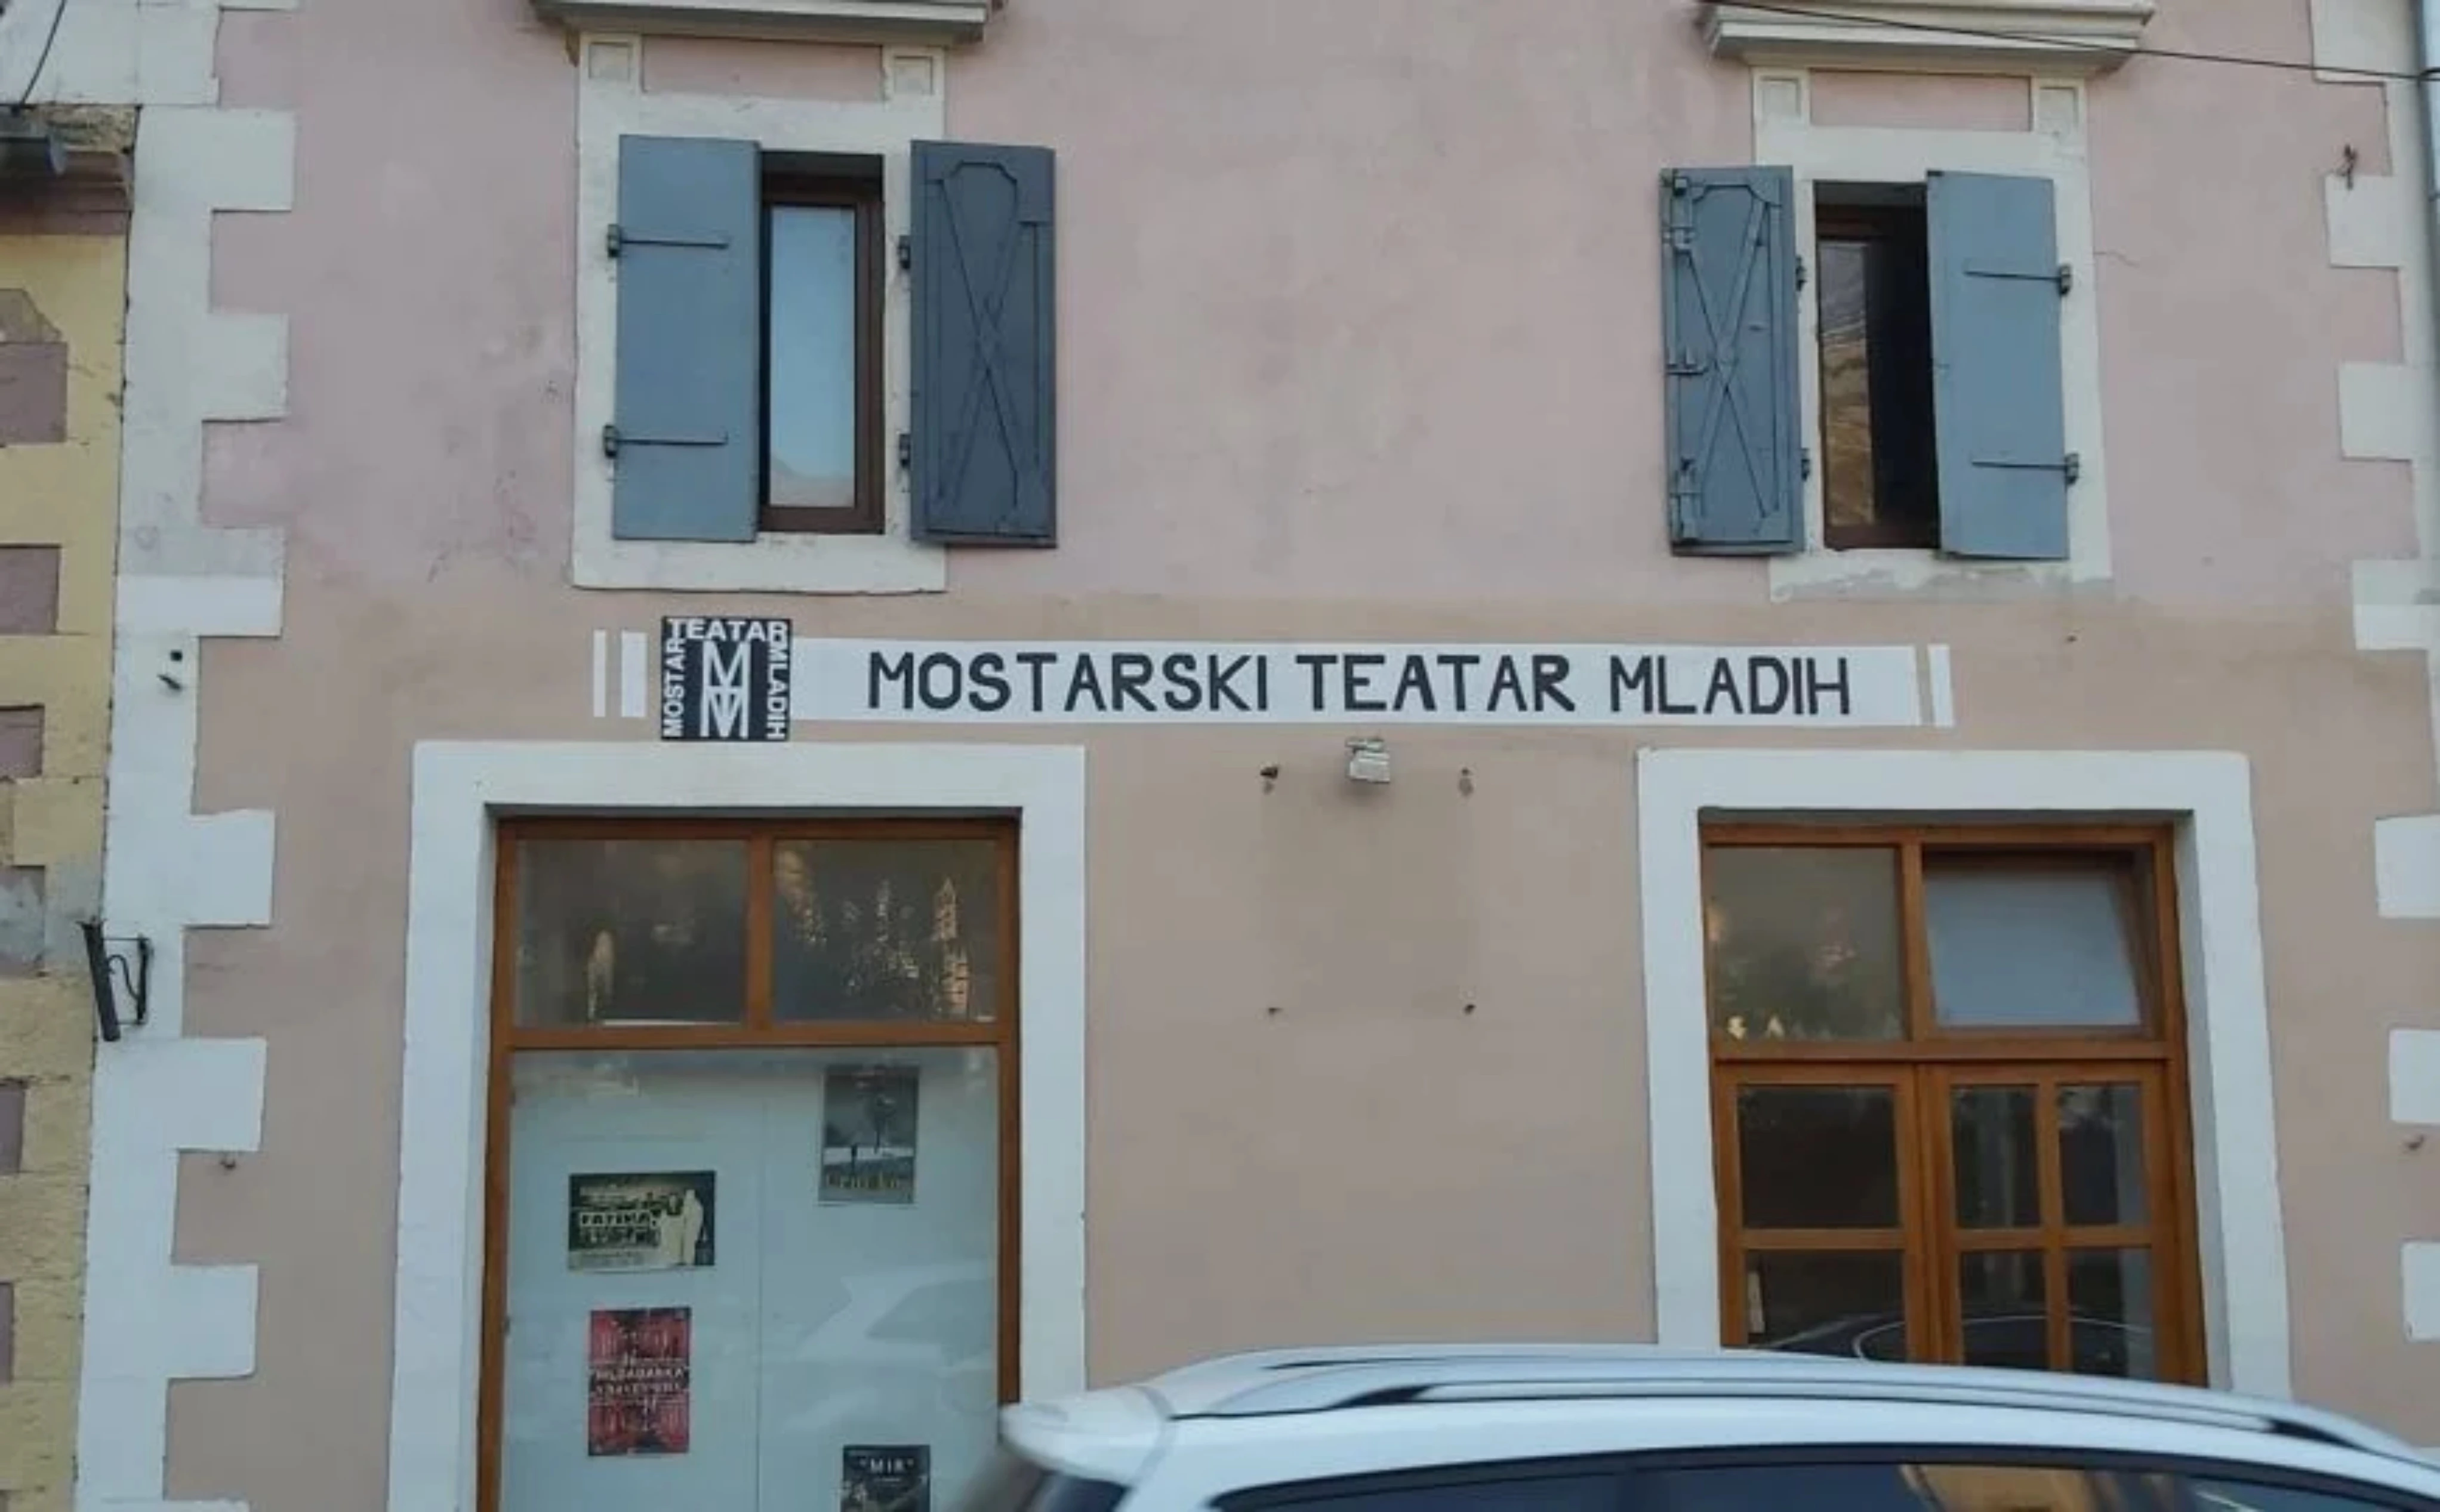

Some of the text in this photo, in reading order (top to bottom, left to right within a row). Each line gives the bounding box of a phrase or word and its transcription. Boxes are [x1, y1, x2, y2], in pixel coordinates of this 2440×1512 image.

[868, 651, 1850, 715] MOSTARSKI TEATAR MLADIH
